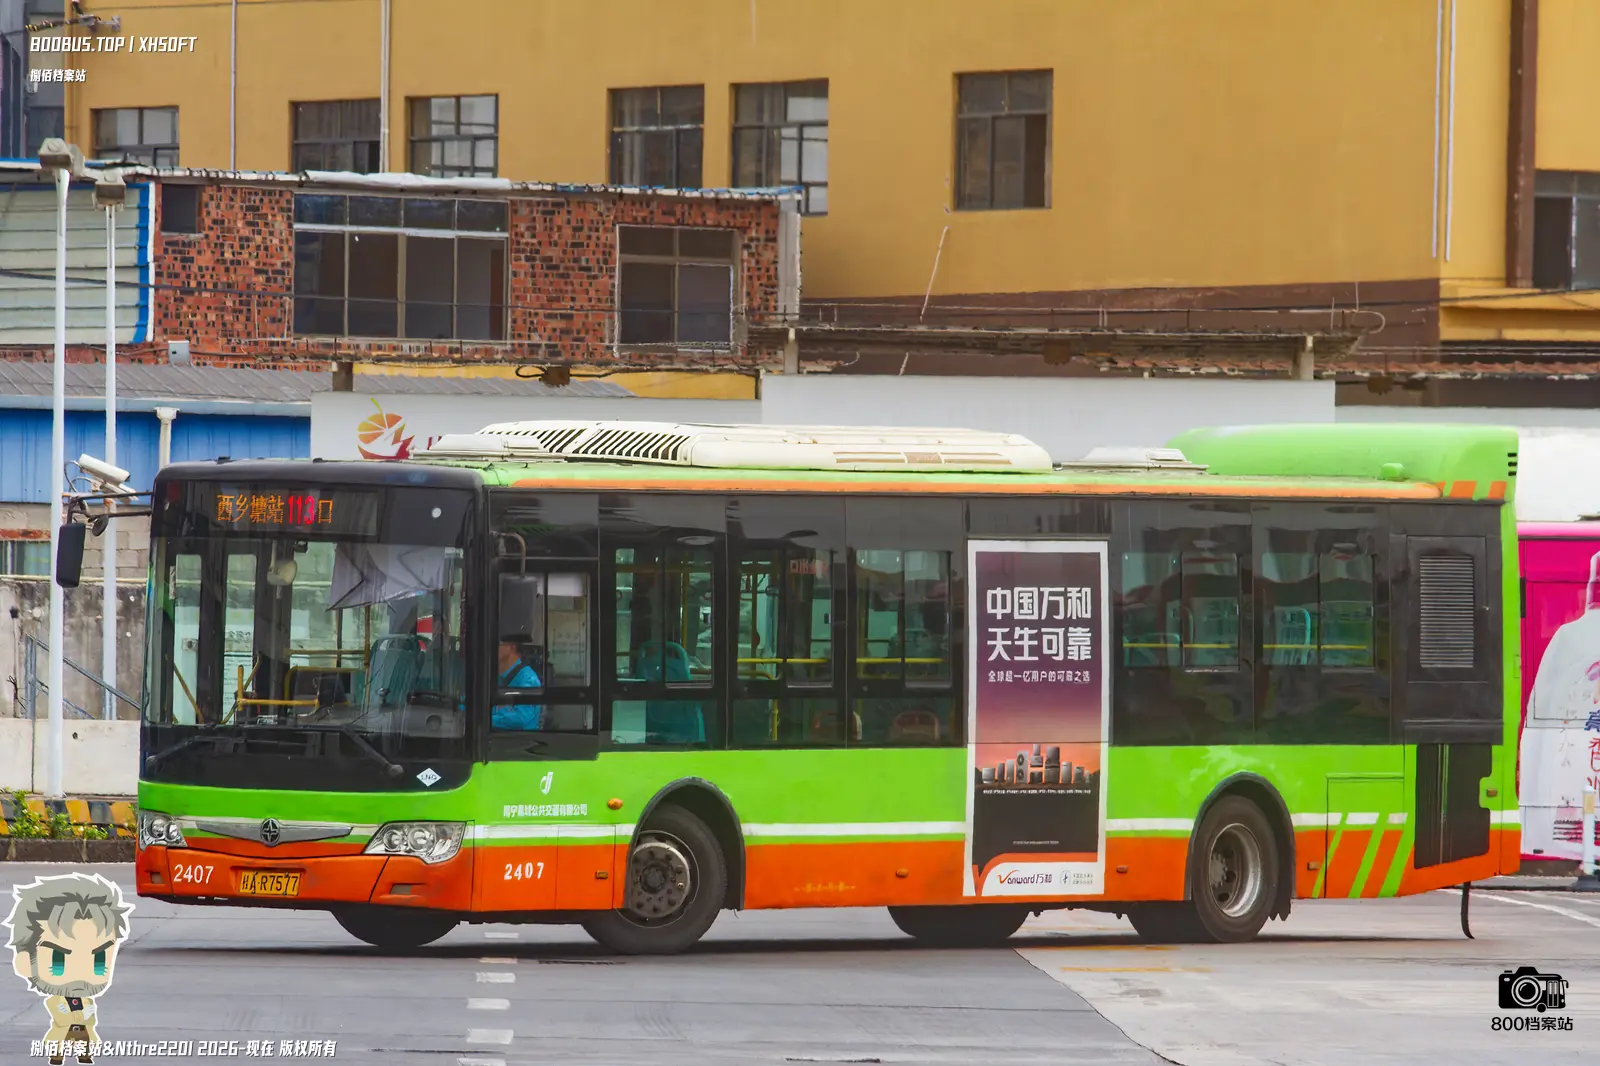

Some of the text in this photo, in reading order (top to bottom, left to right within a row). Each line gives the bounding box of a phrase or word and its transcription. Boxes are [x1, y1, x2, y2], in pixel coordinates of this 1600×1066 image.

[986, 587, 1092, 620] 中国万和
[986, 626, 1092, 661] 天生可靠
[173, 863, 214, 884] 2407
[503, 861, 545, 881] 2407
[997, 869, 1035, 885] Vanward
